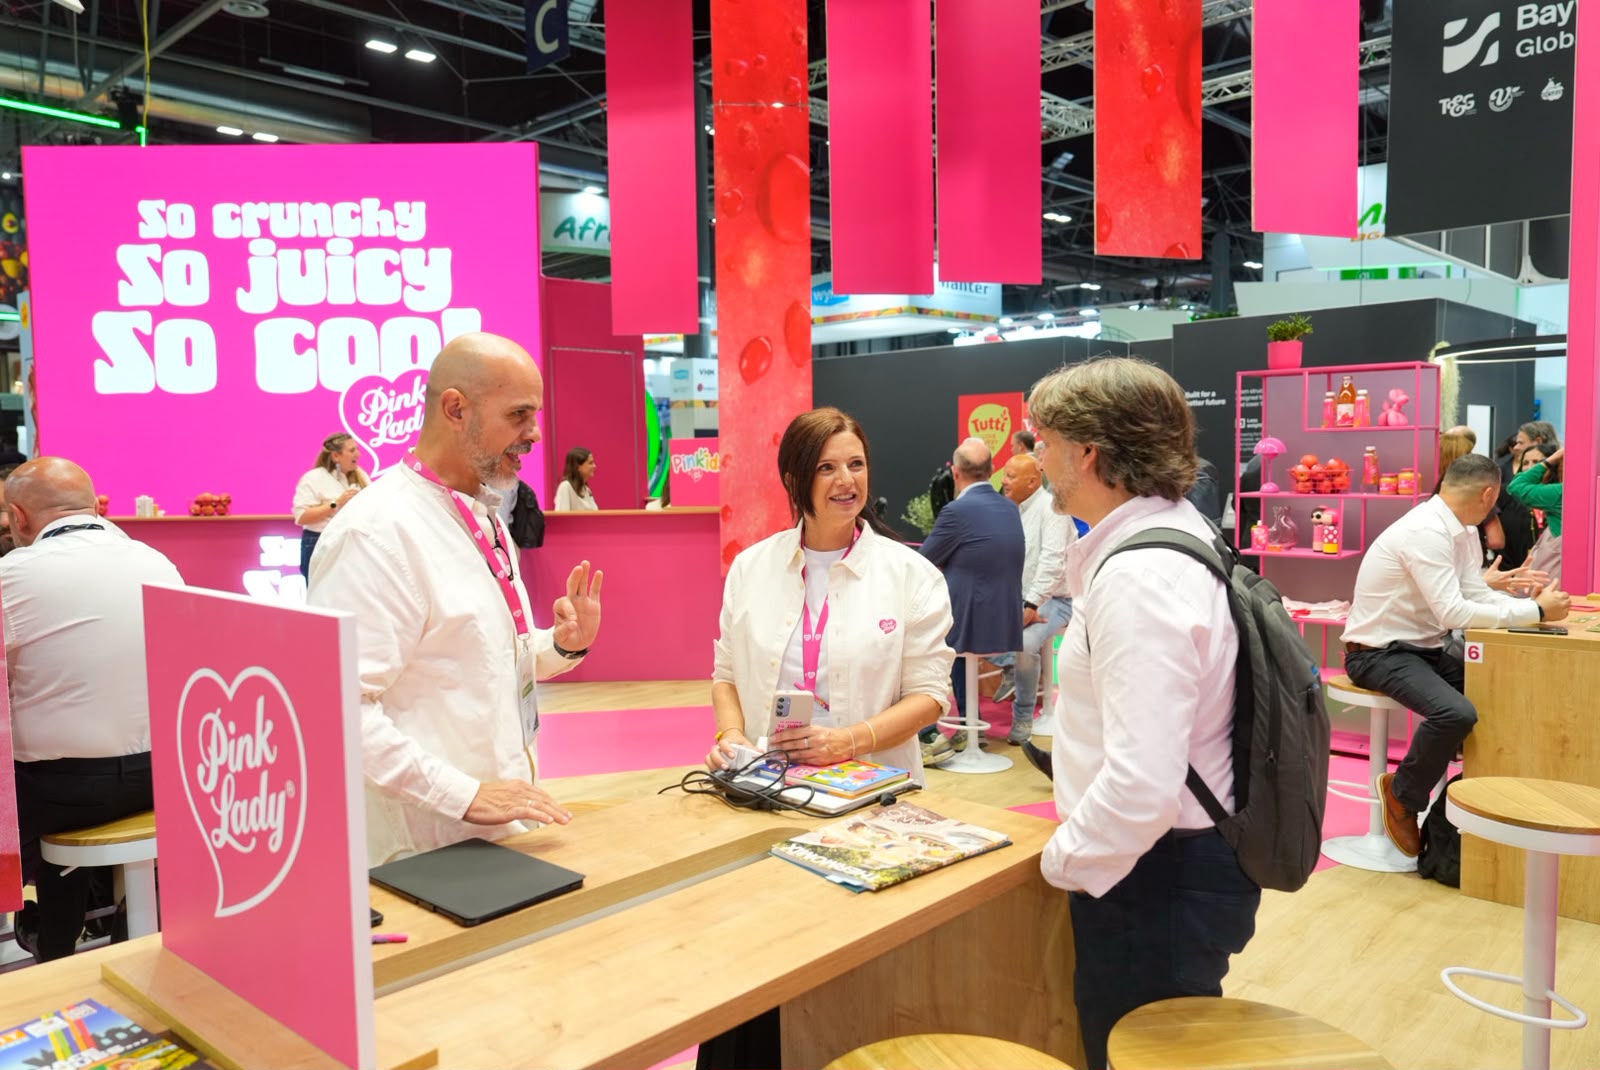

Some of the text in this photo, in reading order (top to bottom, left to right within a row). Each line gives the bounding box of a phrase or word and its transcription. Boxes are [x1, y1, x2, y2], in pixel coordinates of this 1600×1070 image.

[535, 0, 559, 54] C
[1517, 0, 1577, 31] Bay
[1516, 31, 1575, 58] Glob
[138, 197, 427, 242] So crunchy
[553, 215, 611, 242] Afr
[116, 238, 452, 313] So juicy
[92, 310, 217, 394] So
[369, 405, 425, 448] Lad
[971, 417, 1006, 433] Tutti
[671, 447, 720, 474] Pinkid
[1467, 645, 1480, 660] 6
[197, 695, 277, 793] Pink
